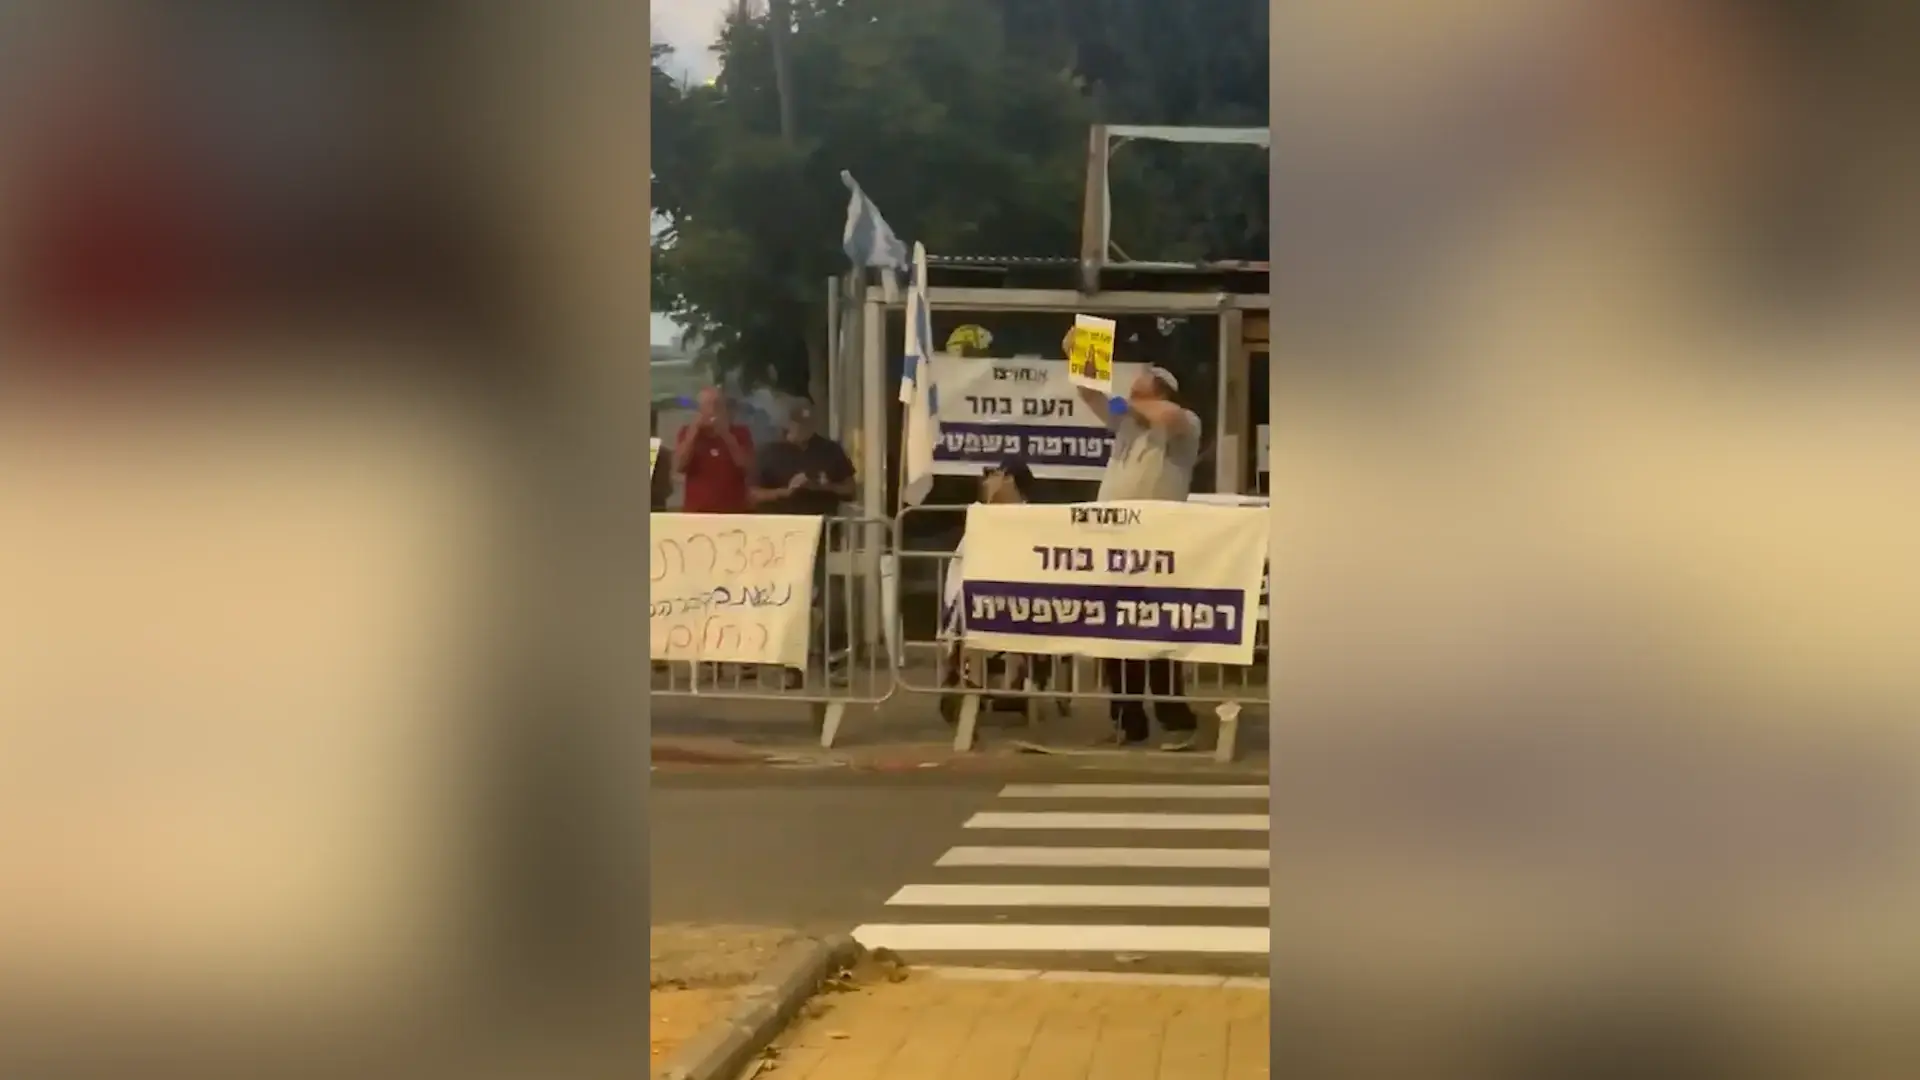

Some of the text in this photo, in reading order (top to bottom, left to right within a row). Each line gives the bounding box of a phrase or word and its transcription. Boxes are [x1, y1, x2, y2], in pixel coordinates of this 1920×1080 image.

[964, 394, 1074, 417] העם בחר
[1032, 544, 1175, 575] העם בחר
[971, 592, 1236, 631] רפורמה משפטית
